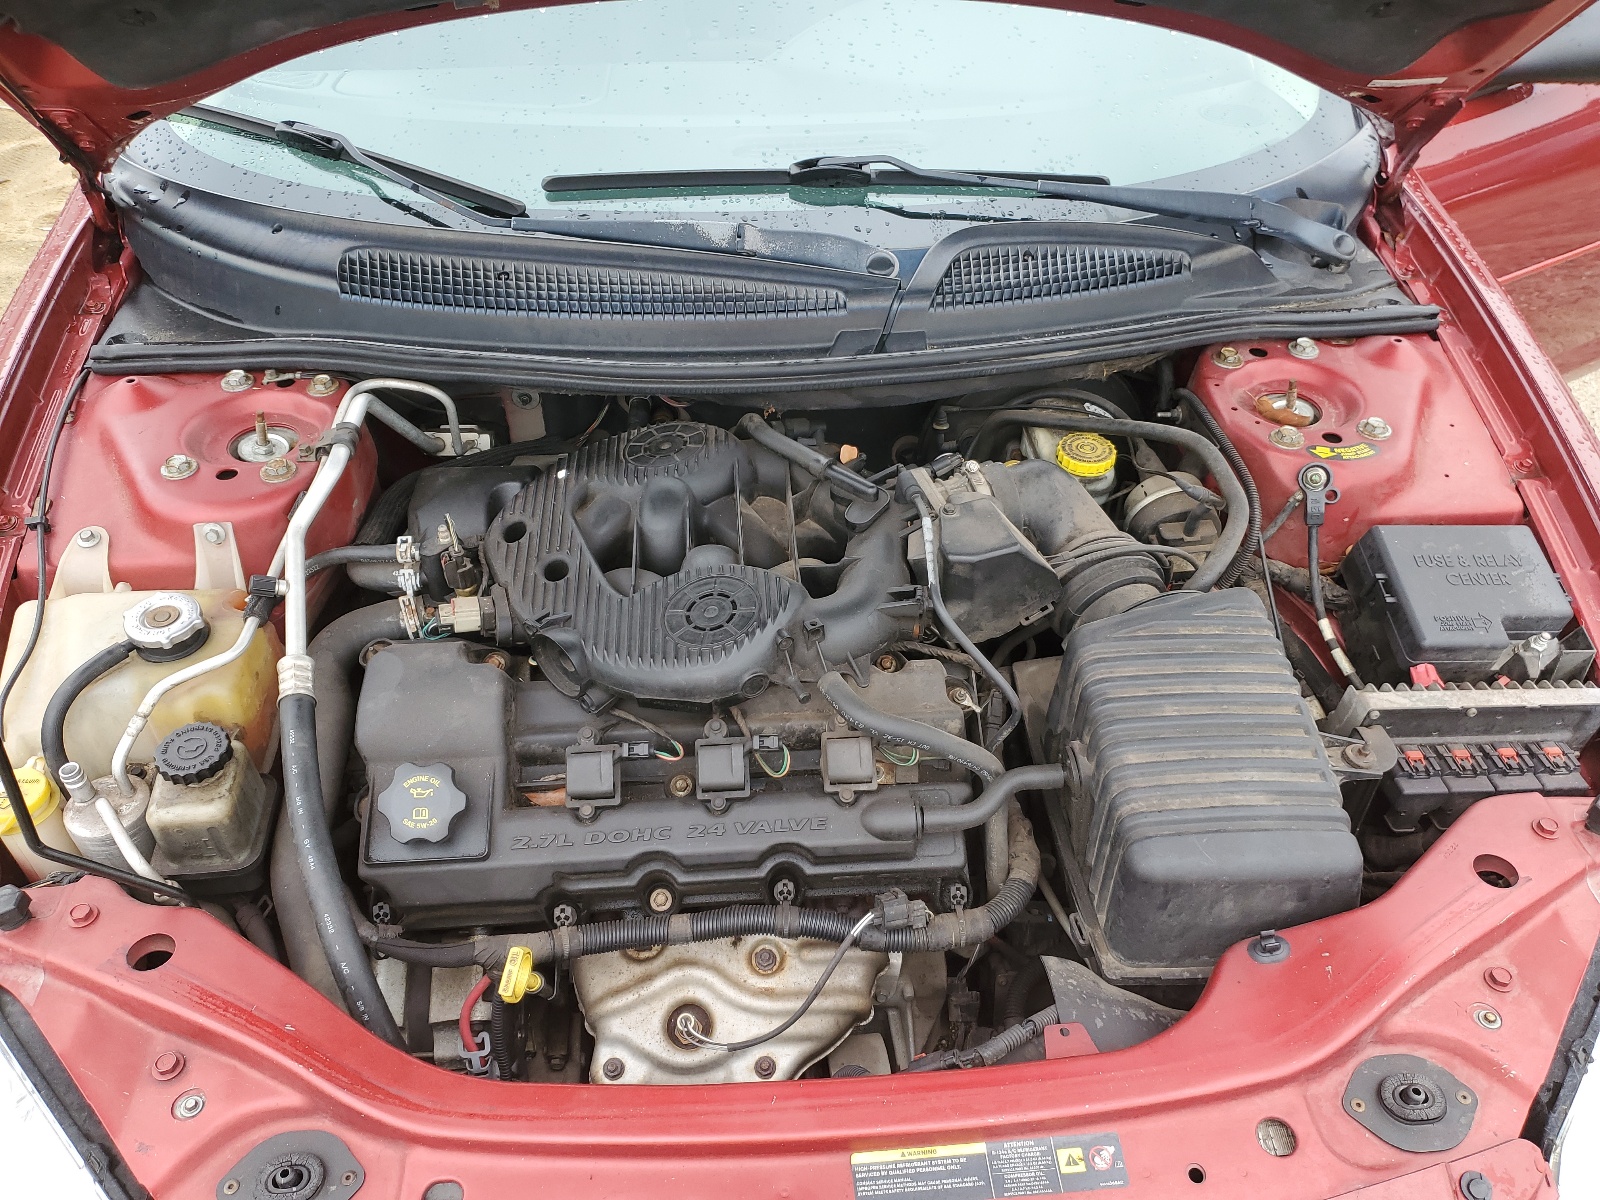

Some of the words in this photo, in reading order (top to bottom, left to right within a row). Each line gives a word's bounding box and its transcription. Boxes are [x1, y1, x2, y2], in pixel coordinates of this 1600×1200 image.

[1412, 553, 1453, 568] FUSE
[1458, 554, 1471, 567] &
[1473, 553, 1523, 568] RELAY
[1446, 572, 1511, 586] CENTER
[403, 775, 429, 788] ENGINE
[430, 777, 441, 788] OIL
[402, 818, 416, 829] SAE
[416, 817, 438, 829] 5W-20
[511, 832, 575, 850] 2.7L
[583, 826, 672, 846] DOHC
[686, 822, 726, 839] 24
[733, 817, 828, 836] VALVE
[340, 961, 350, 975] A/C
[1003, 1140, 1035, 1148] ATTENTION
[906, 1148, 937, 1157] WARNING
